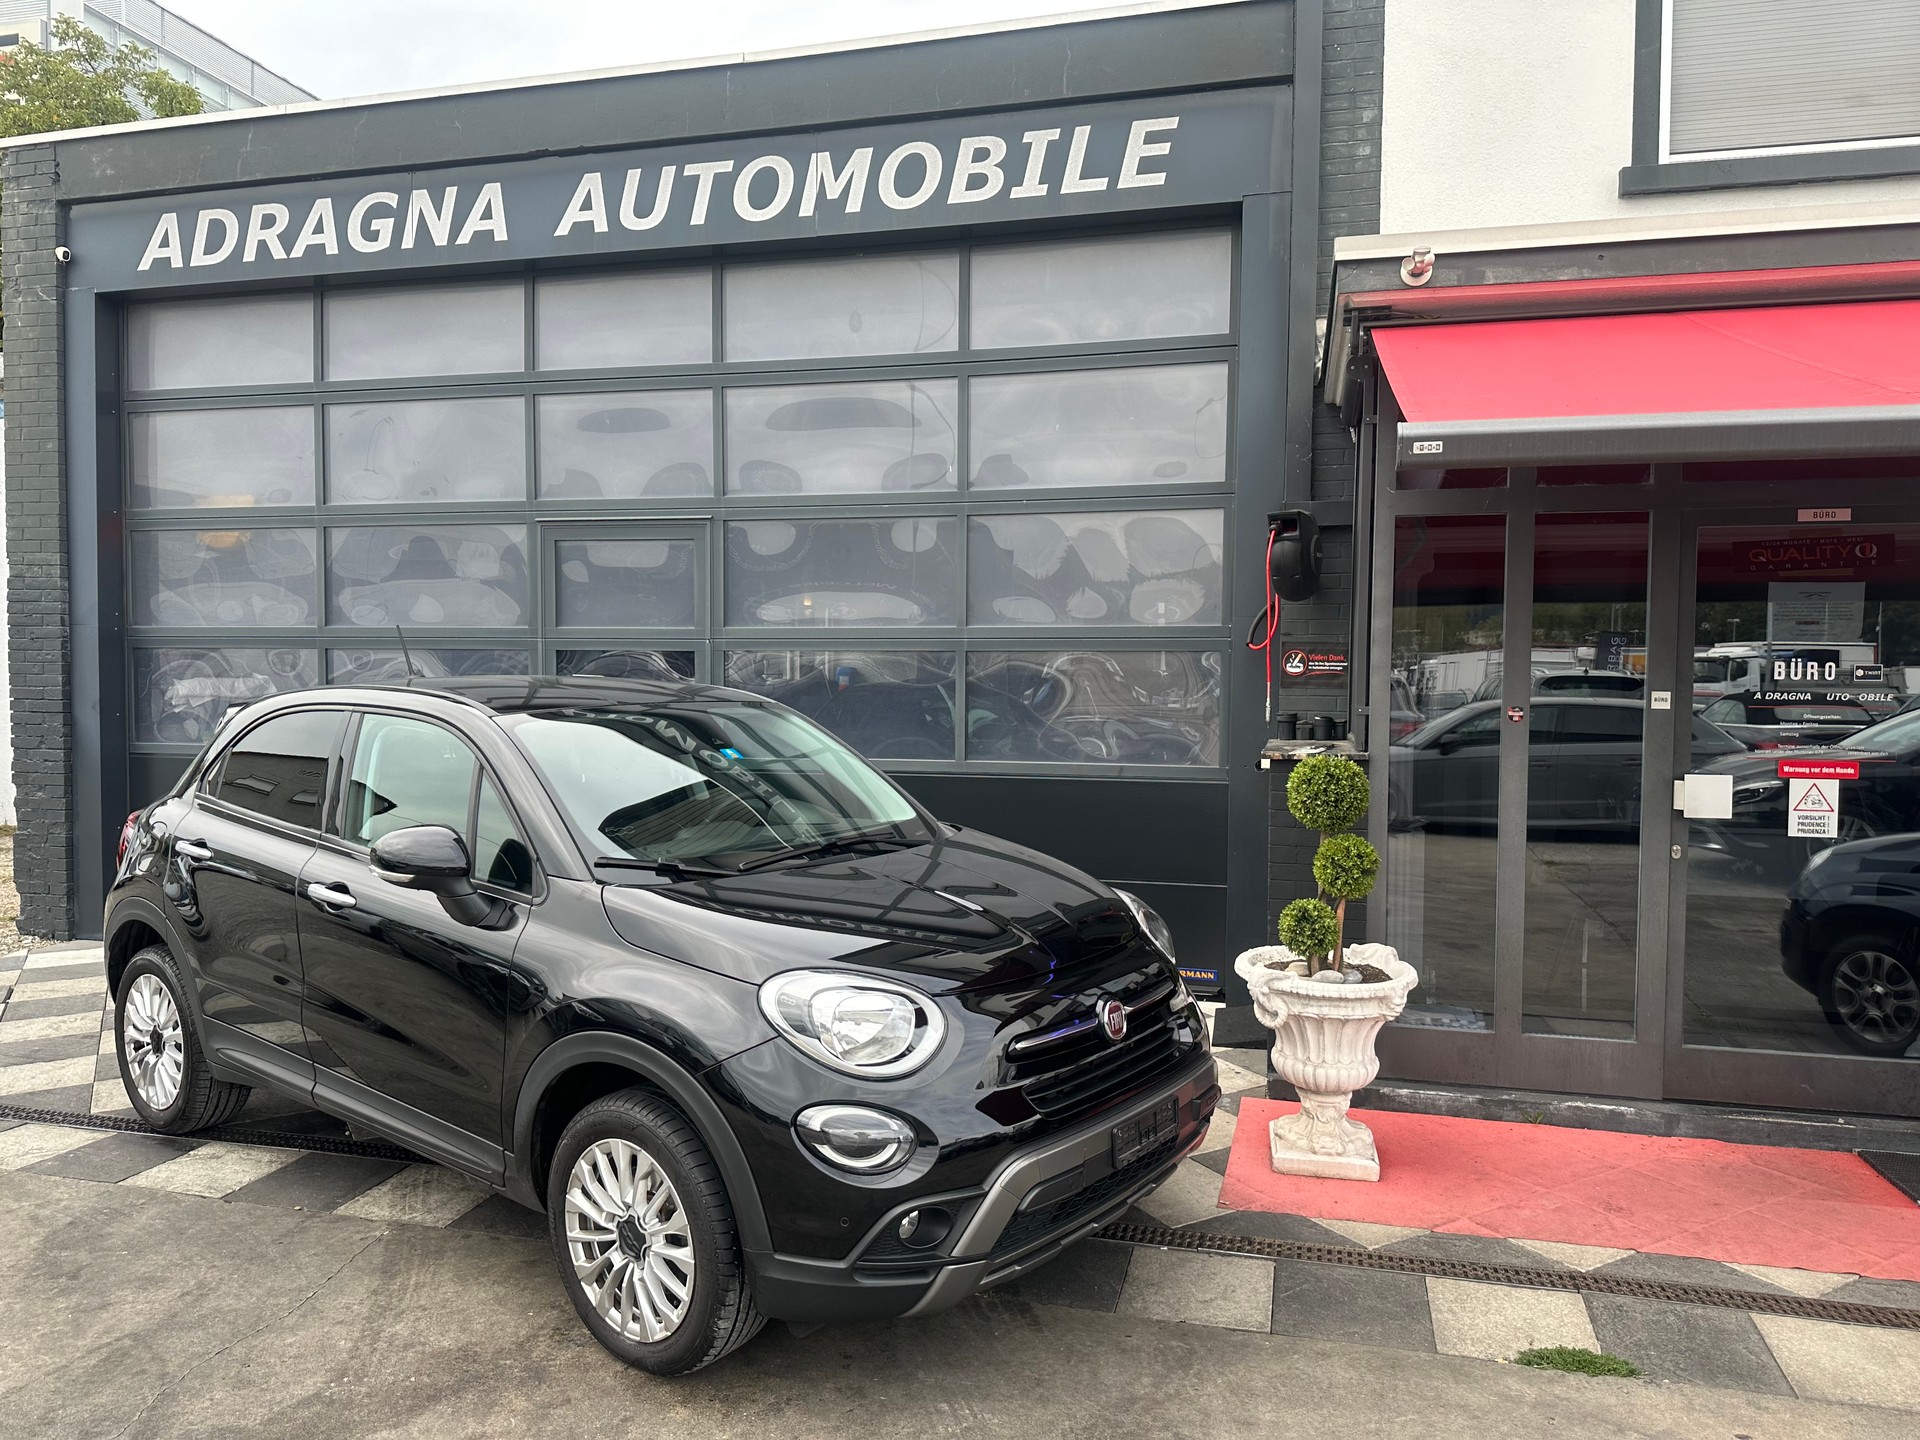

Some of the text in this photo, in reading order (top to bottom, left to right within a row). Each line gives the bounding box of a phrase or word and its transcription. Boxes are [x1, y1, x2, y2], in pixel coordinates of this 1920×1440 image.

[137, 116, 1180, 271] ADRAGNA AUTOMOBILE
[1813, 510, 1837, 519] BÜRO
[1749, 544, 1852, 563] QUALITY
[1750, 560, 1877, 571] GARANTIE
[1308, 653, 1328, 661] Vielen
[1774, 658, 1837, 681] BÜRO
[1783, 765, 1810, 774] Warnung
[1821, 766, 1835, 774] dem
[1835, 766, 1855, 775] Hunde
[1109, 1011, 1123, 1031] FIAT
